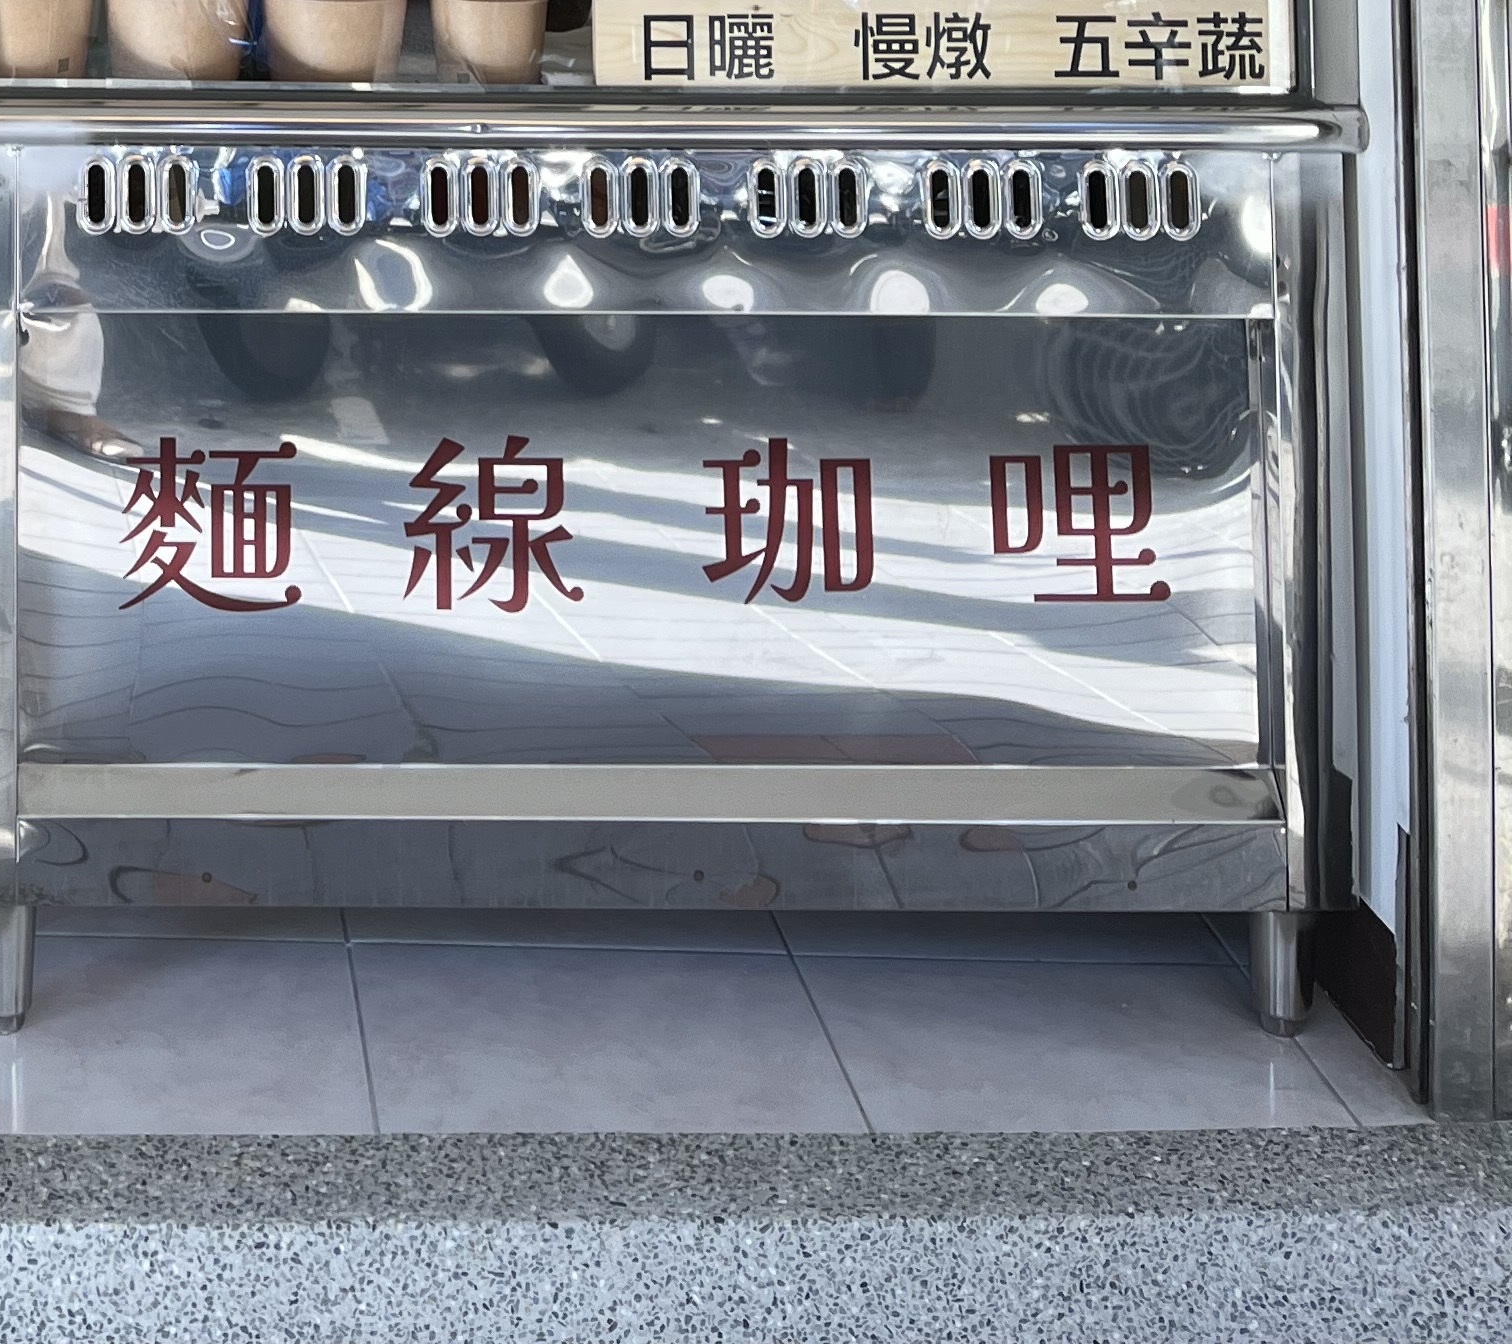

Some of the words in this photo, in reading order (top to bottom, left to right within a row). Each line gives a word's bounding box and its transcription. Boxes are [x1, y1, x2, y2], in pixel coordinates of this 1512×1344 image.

[643, 13, 775, 80] 日曬
[854, 12, 992, 81] 慢燉
[1054, 12, 1264, 81] 五辛蔬
[119, 435, 1172, 613] 麵線珈哩
